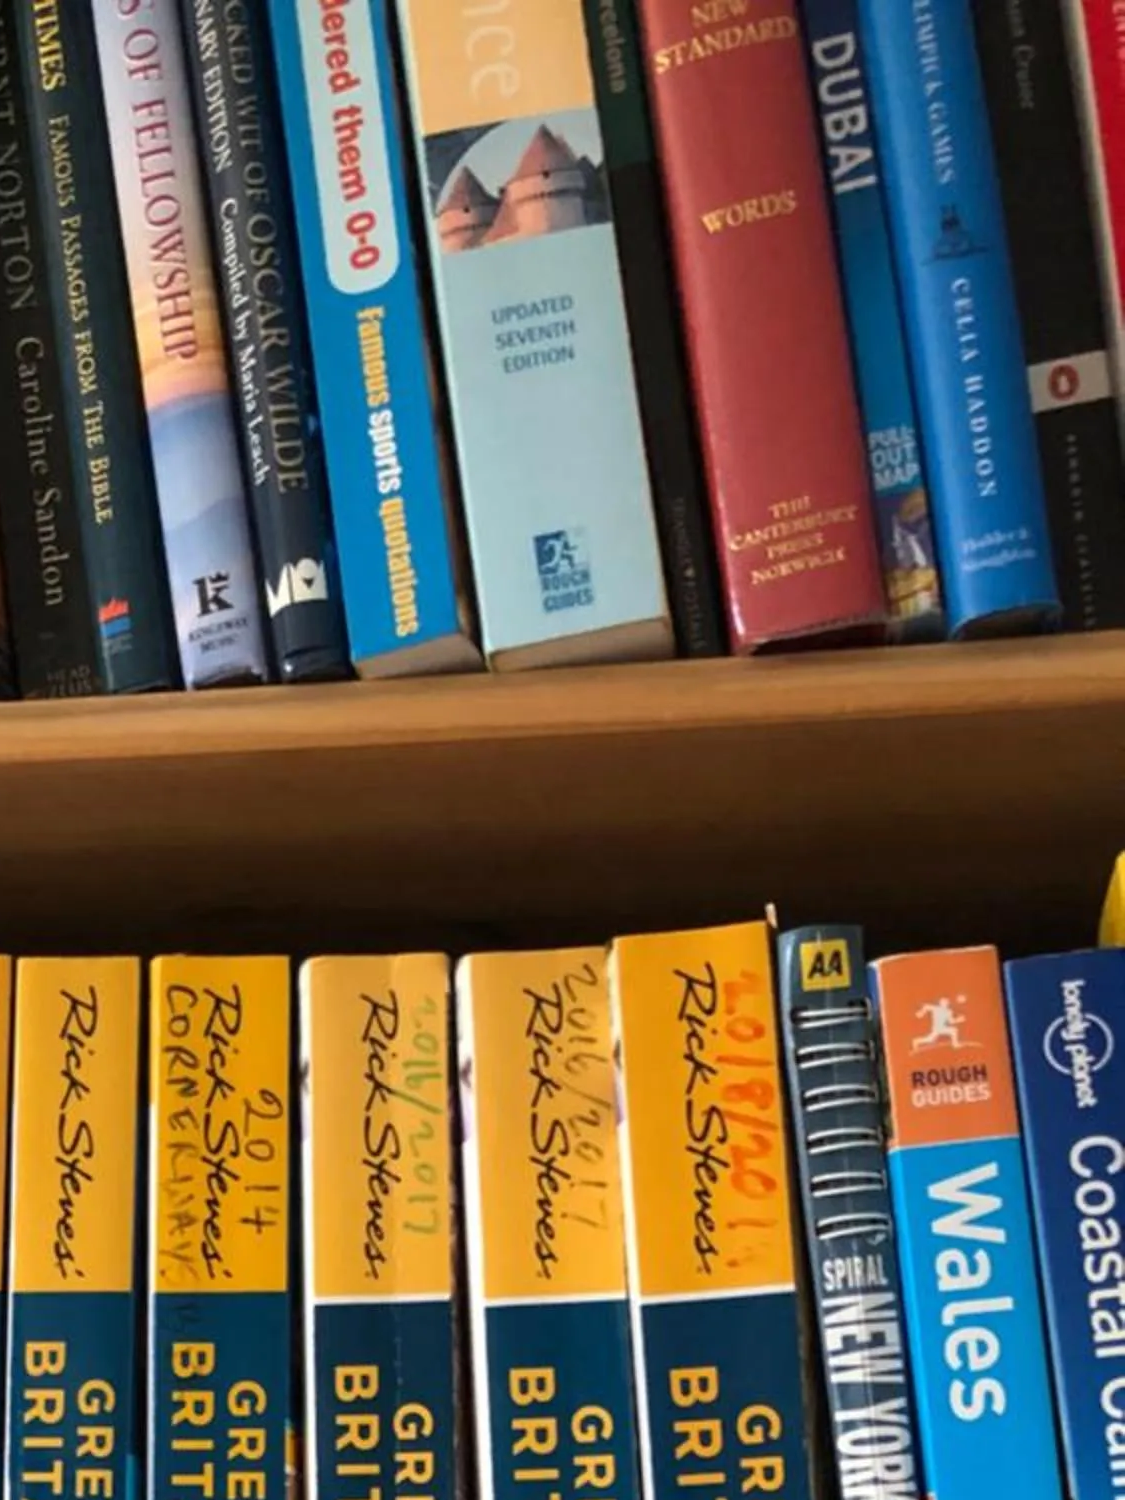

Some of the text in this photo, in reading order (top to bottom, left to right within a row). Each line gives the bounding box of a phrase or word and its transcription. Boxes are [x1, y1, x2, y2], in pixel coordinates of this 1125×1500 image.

[655, 17, 796, 76] STANDARD
[812, 32, 878, 194] DUBAI
[124, 30, 197, 360] OF FELLOWSHIP
[333, 107, 378, 273] them 0-0
[700, 190, 796, 236] WORDS
[49, 115, 113, 523] FAMOUS PASSAGES FROM THE BIBLE
[220, 198, 270, 487] Compiled by Maria Leach
[492, 295, 573, 326] UPDATED
[495, 320, 575, 350] SEVENTH
[503, 347, 574, 373] EDITION
[950, 277, 996, 500] CELIA HADDON
[14, 337, 69, 607] Caroline Sandon
[356, 306, 418, 639] Famous sports quotations
[911, 1066, 988, 1088] ROUGH
[911, 1085, 991, 1108] GUIDES
[242, 1089, 283, 1234] 2014
[823, 1291, 902, 1386] NEW
[927, 1162, 1014, 1421] Wales
